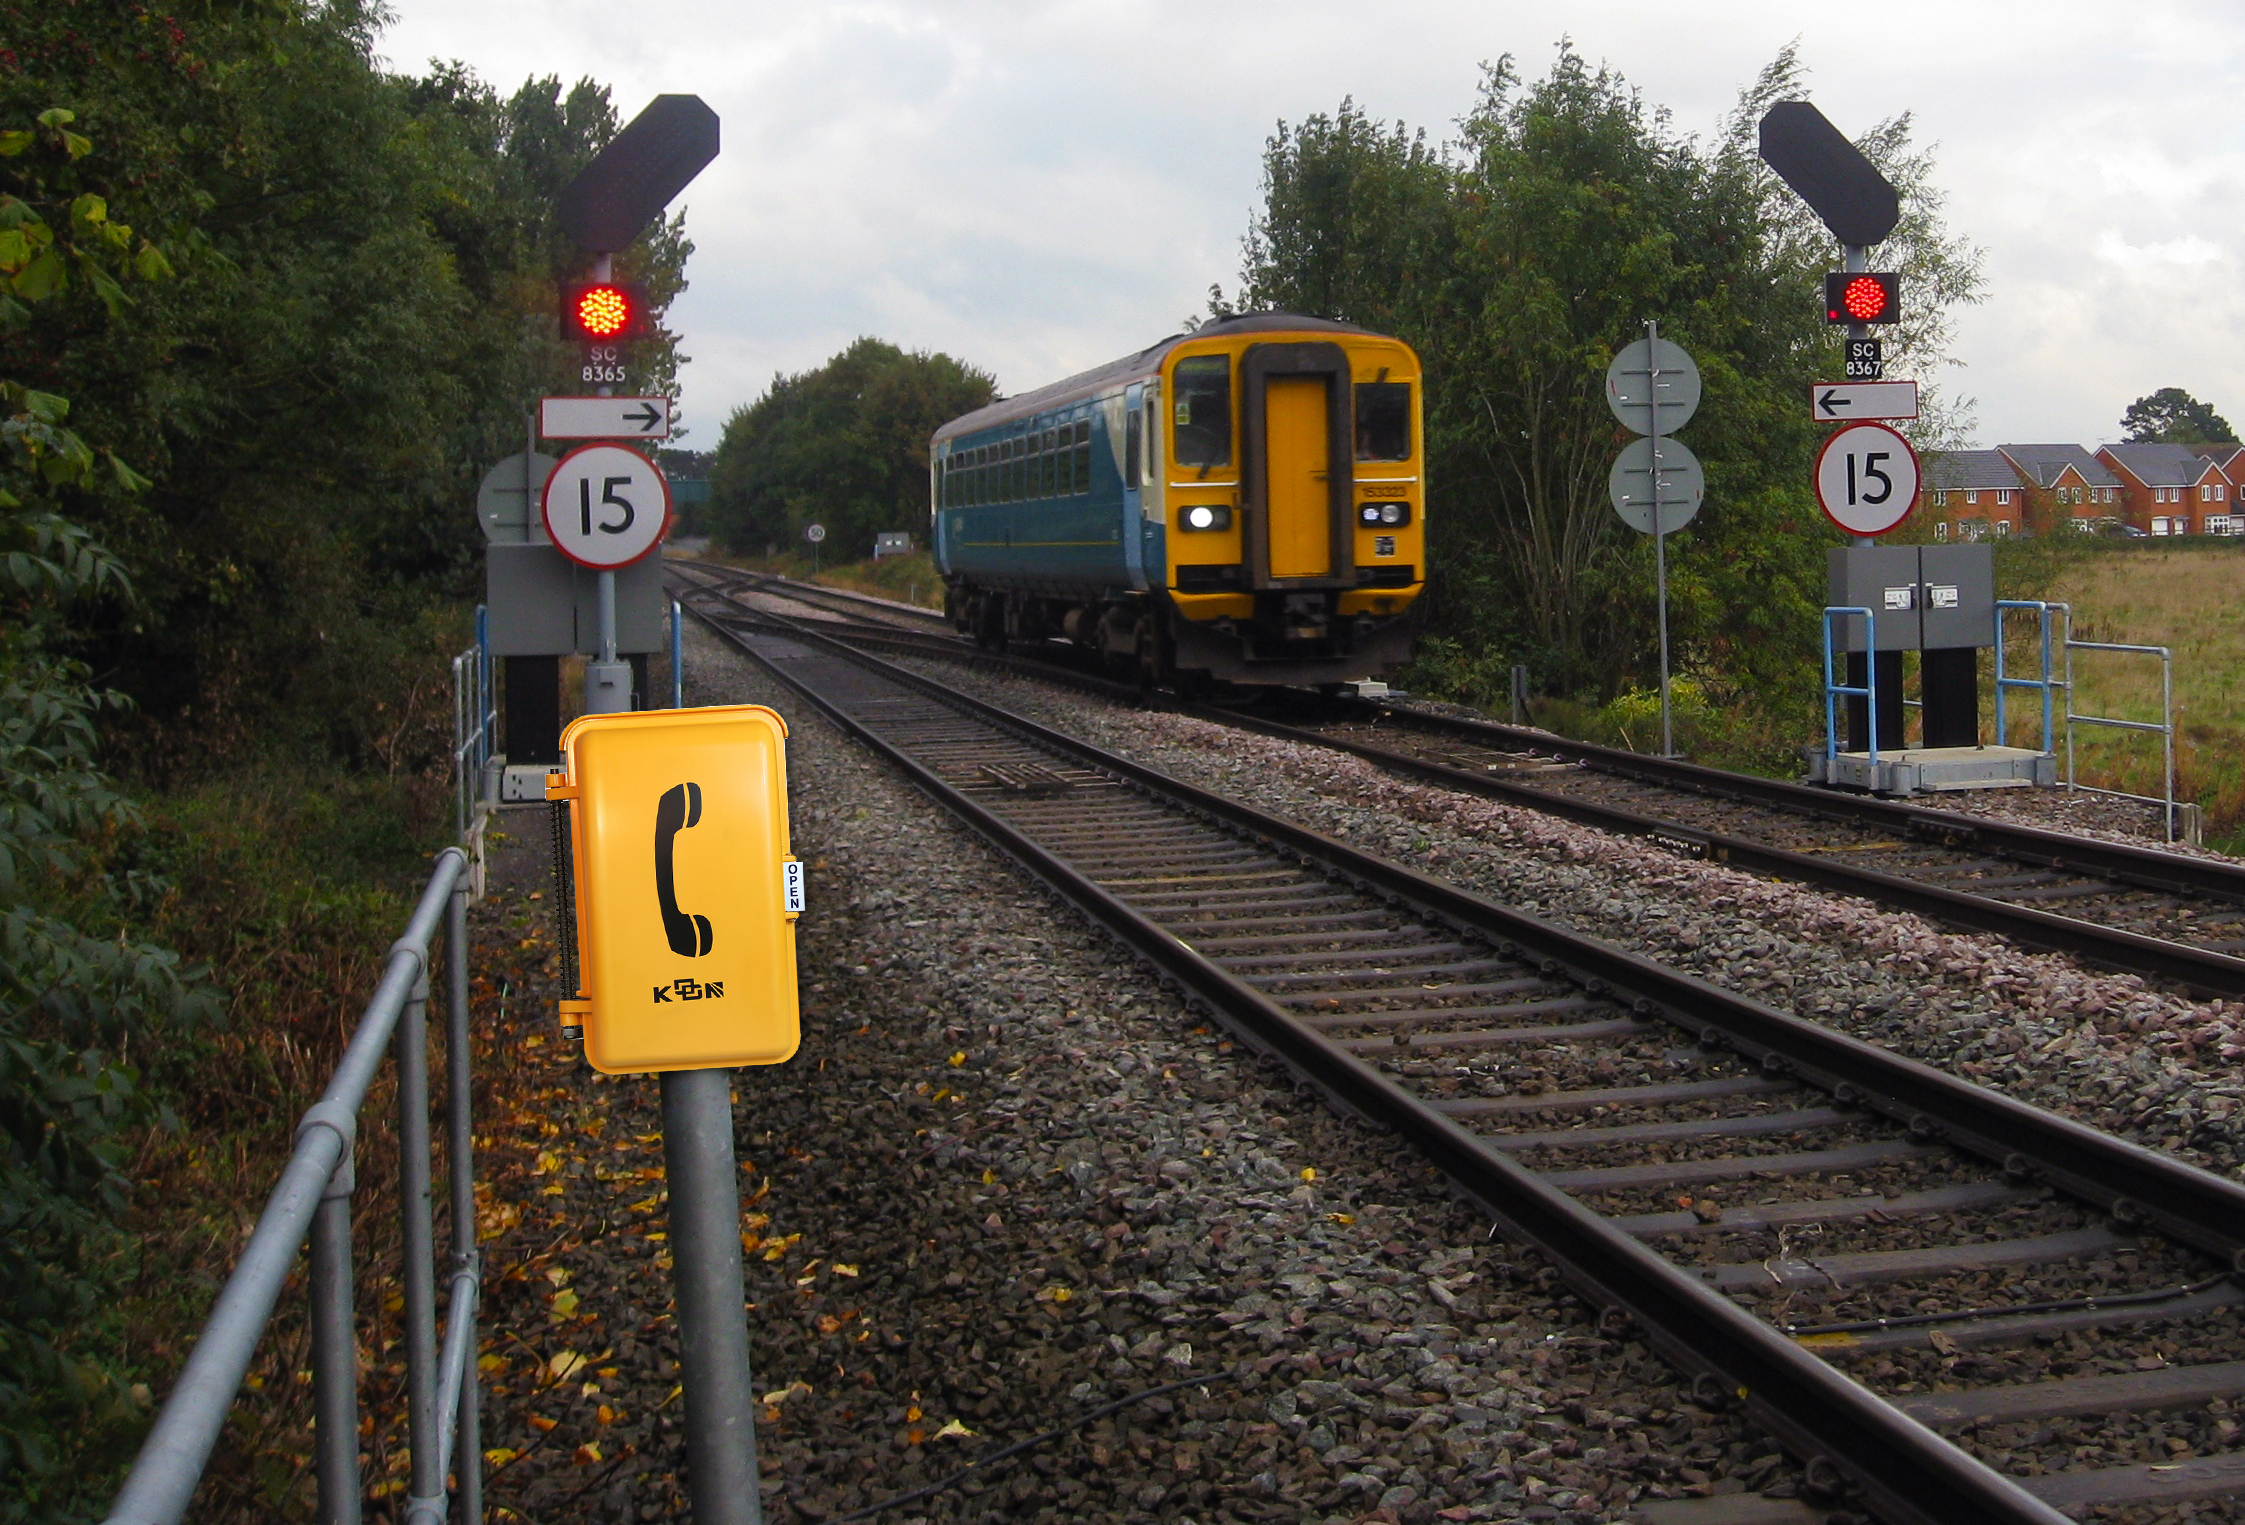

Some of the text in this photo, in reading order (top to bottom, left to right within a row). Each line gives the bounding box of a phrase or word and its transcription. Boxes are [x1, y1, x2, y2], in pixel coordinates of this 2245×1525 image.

[590, 346, 617, 362] SC
[1852, 343, 1875, 358] SC
[582, 366, 626, 382] 8365
[1846, 361, 1881, 376] 8367
[1846, 452, 1894, 506] 15
[579, 476, 635, 536] 15
[787, 863, 800, 909] OPEN
